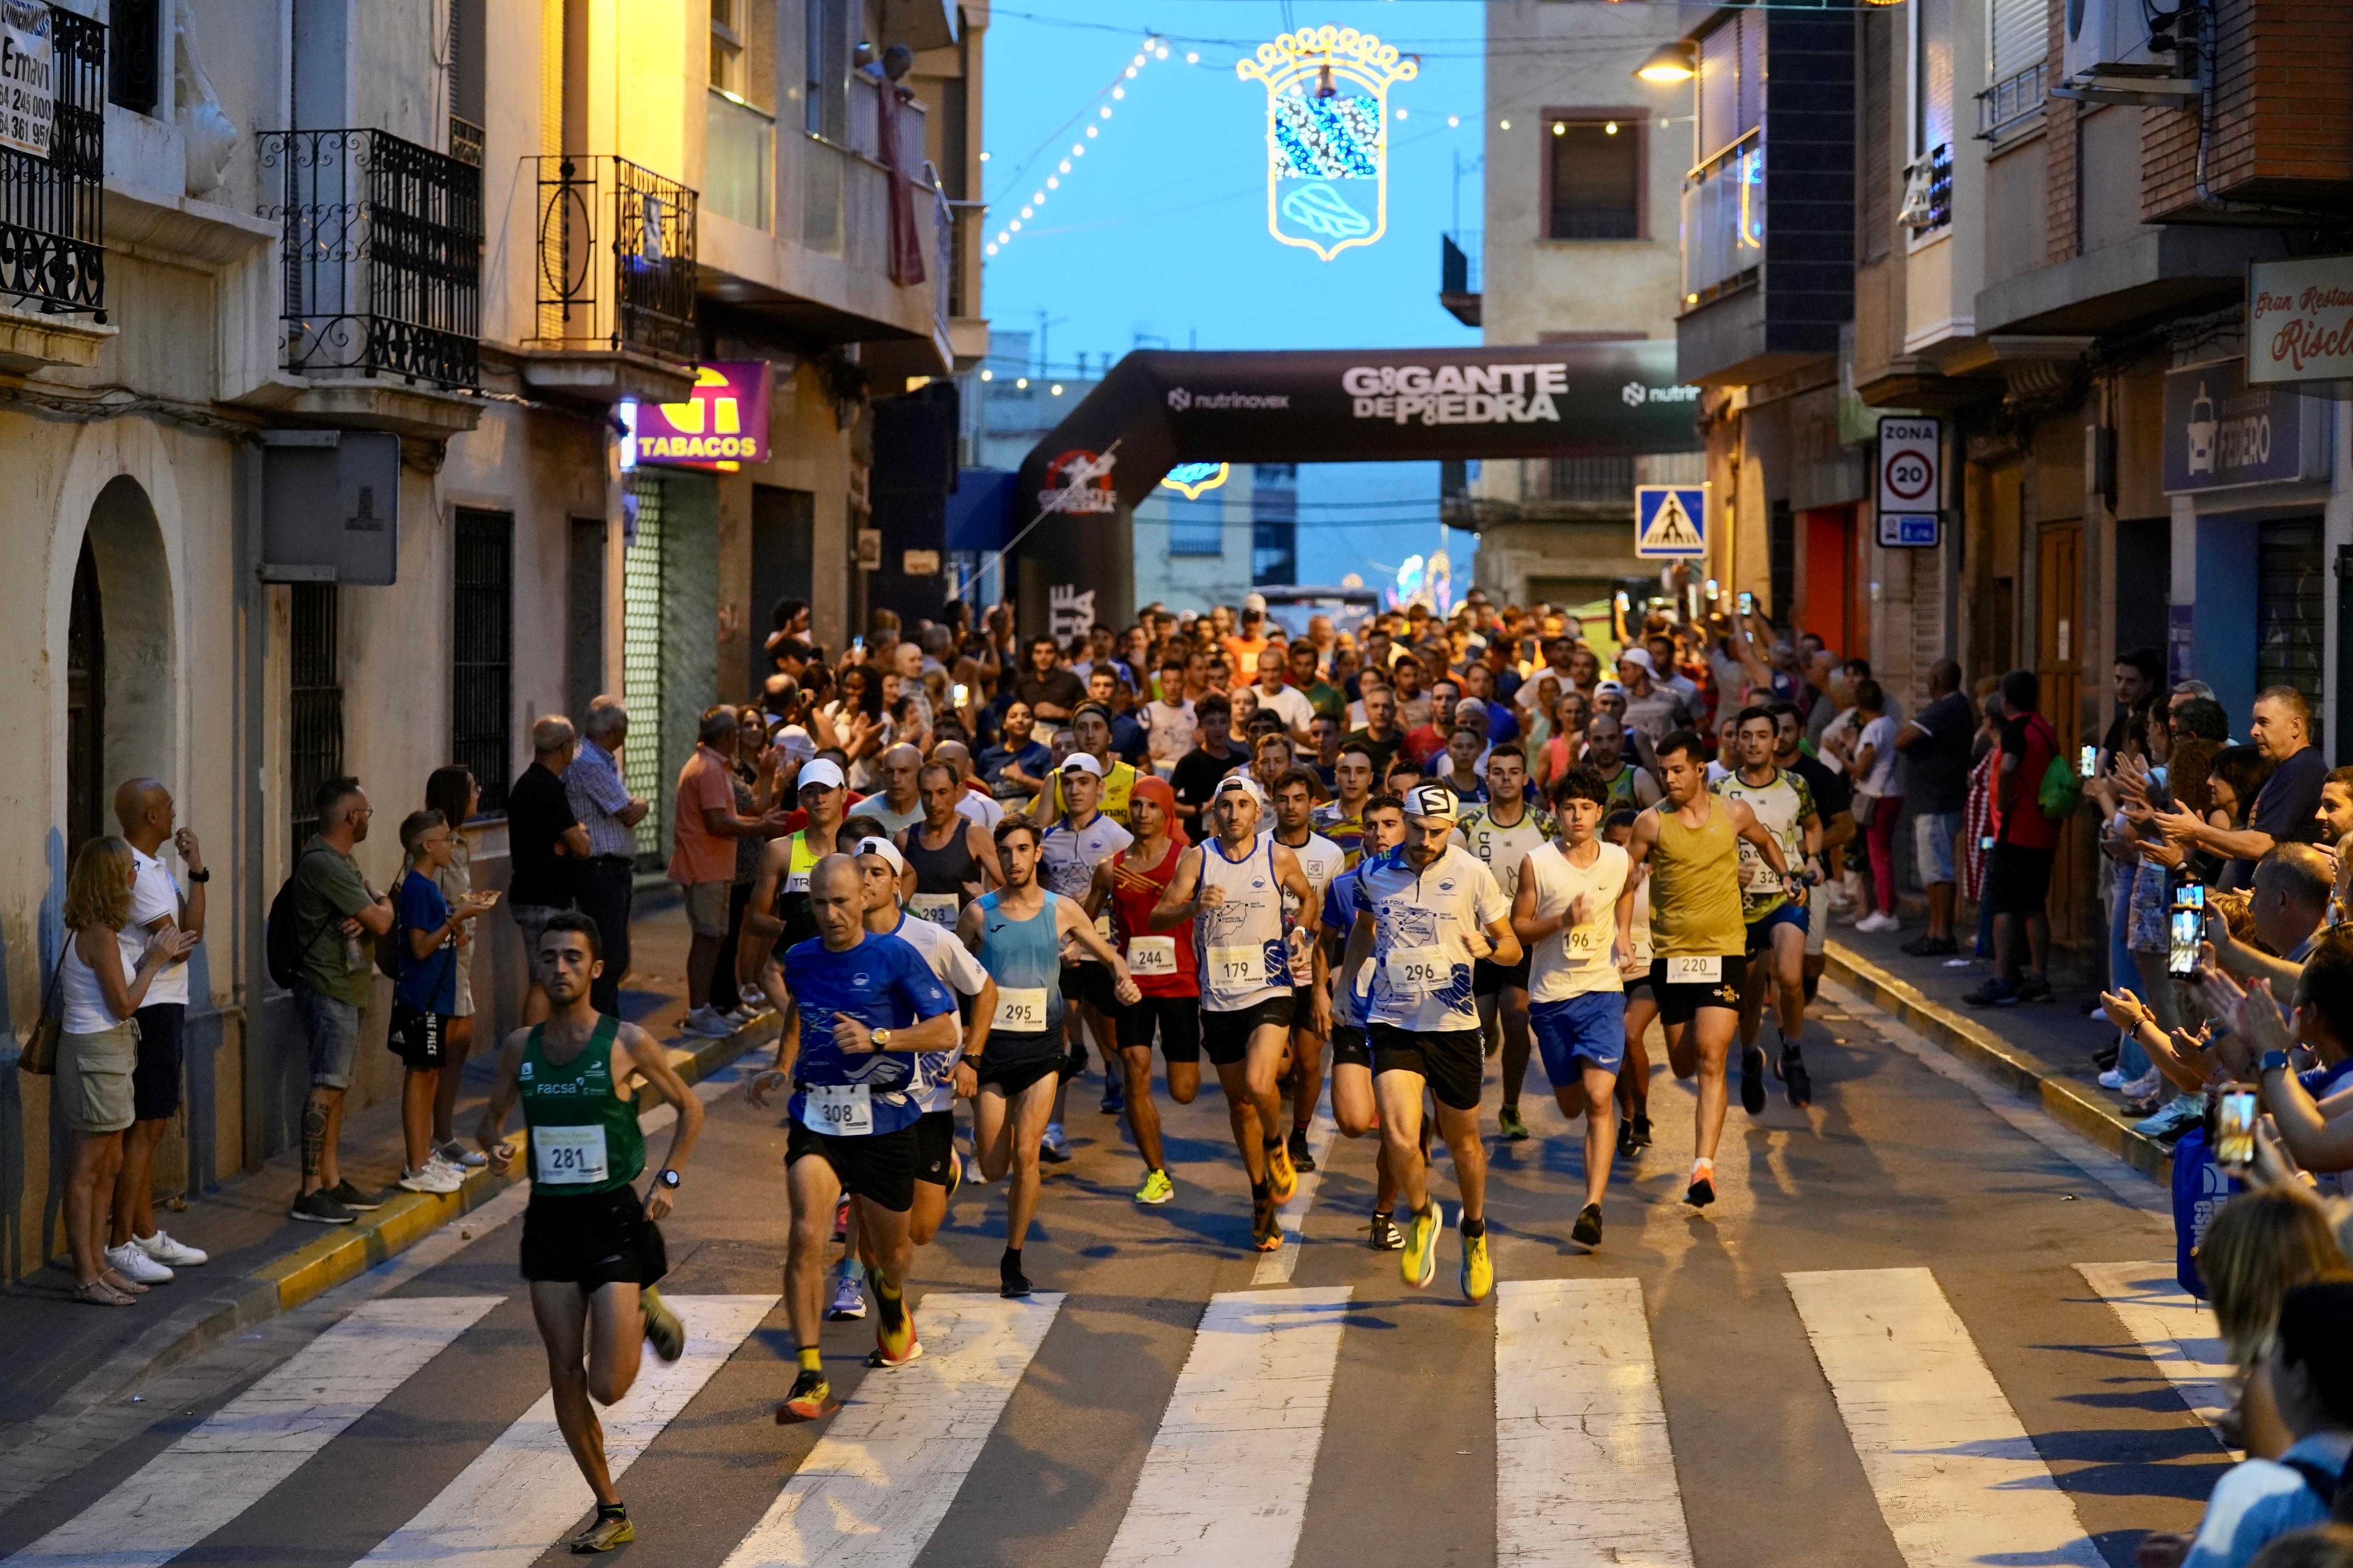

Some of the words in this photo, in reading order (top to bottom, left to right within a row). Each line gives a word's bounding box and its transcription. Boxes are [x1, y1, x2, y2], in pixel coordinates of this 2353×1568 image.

[12, 88, 31, 115] 245
[33, 95, 51, 121] 000
[11, 116, 28, 142] 361
[33, 123, 50, 147] 951
[2255, 291, 2292, 318] Gran
[2272, 318, 2353, 371] Riscl
[1342, 364, 1569, 397] GIGANTE
[1195, 391, 1290, 409] nutrinovex
[1353, 397, 1394, 418] DE
[1885, 426, 1933, 439] ZONA
[637, 437, 757, 457] TABACOS
[1896, 466, 1922, 482] 20
[922, 908, 946, 921] 293
[1563, 933, 1589, 948] 196
[1139, 951, 1162, 965] 244
[1682, 959, 1707, 972] 220
[1224, 962, 1248, 978] 179
[1405, 964, 1434, 981] 296
[1006, 1004, 1031, 1020] 295
[426, 1030, 437, 1056] PIECE
[822, 1104, 853, 1123] 308
[552, 1148, 584, 1168] 281
